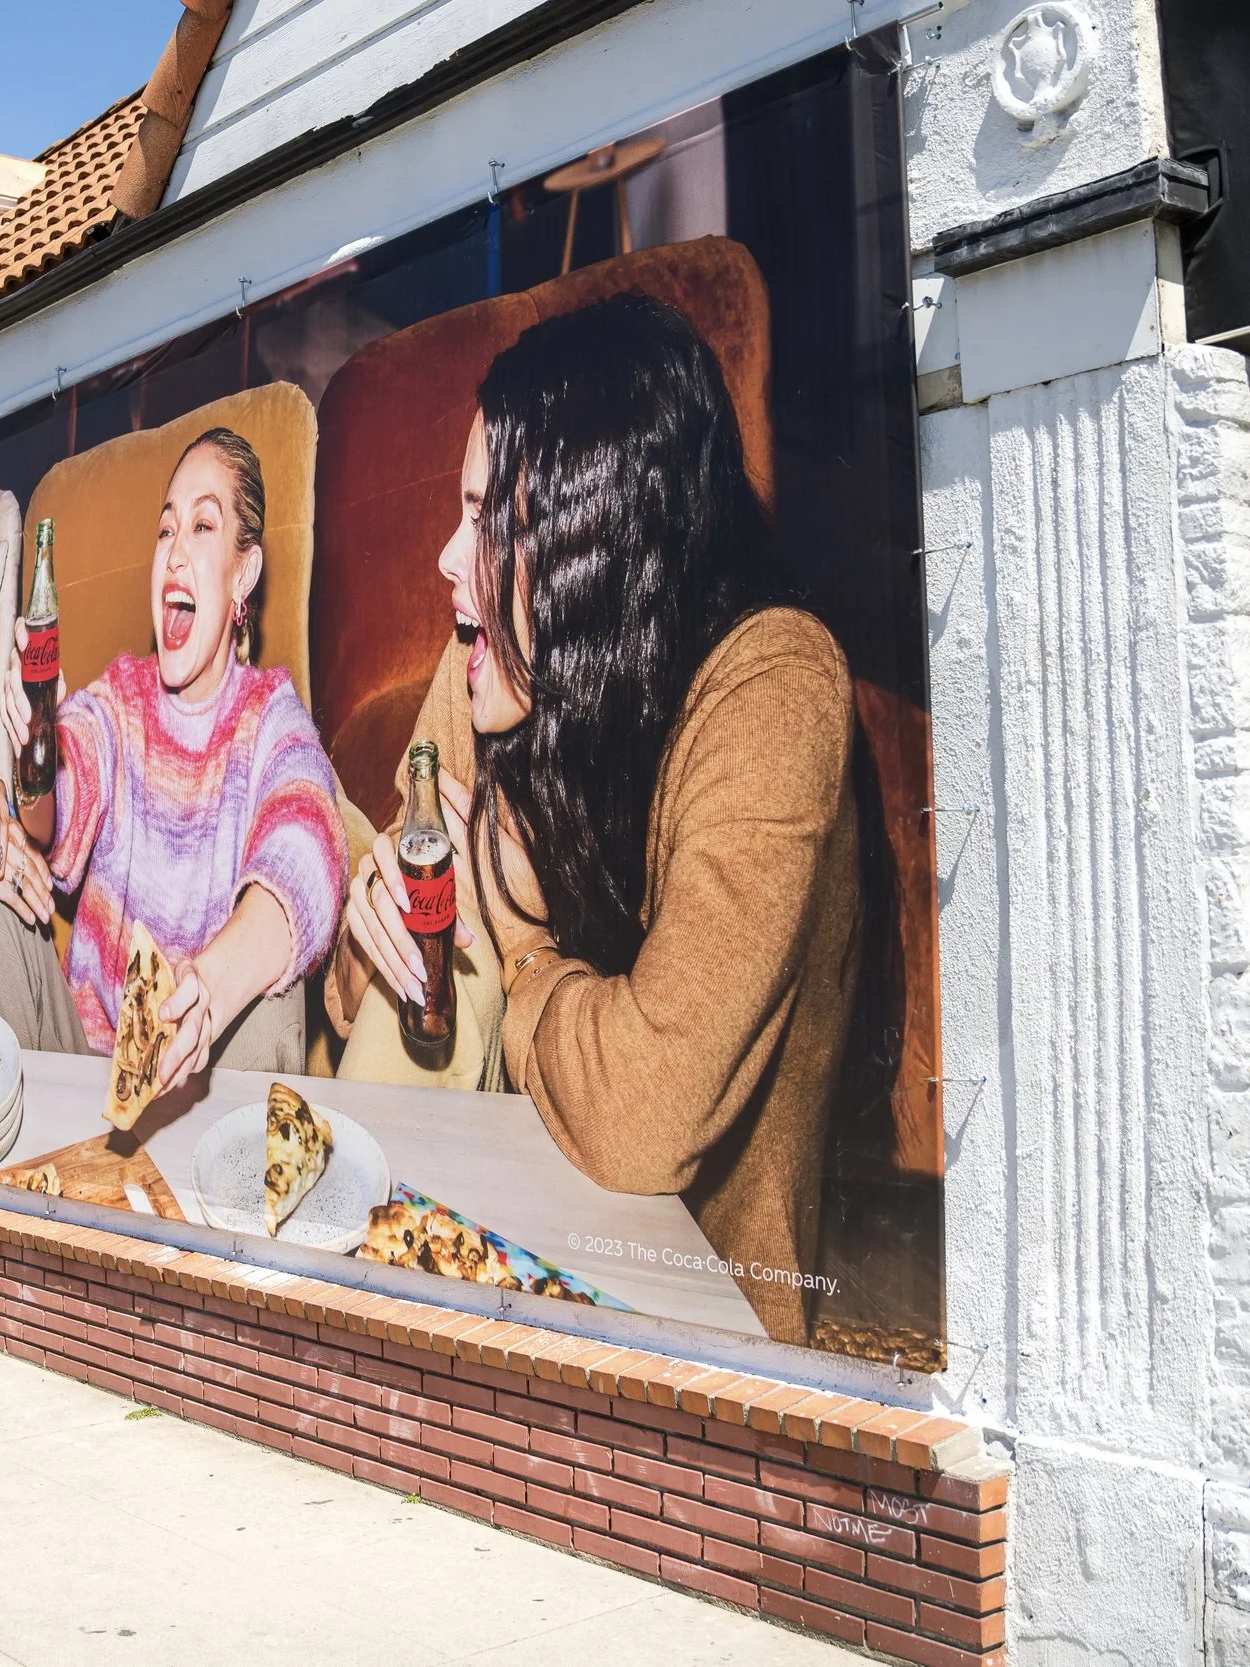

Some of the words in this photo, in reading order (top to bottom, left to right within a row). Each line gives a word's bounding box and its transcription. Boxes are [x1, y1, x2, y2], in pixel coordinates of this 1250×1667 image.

[585, 1235, 623, 1257] 2023
[627, 1241, 657, 1263] The
[749, 1261, 842, 1297] Company.
